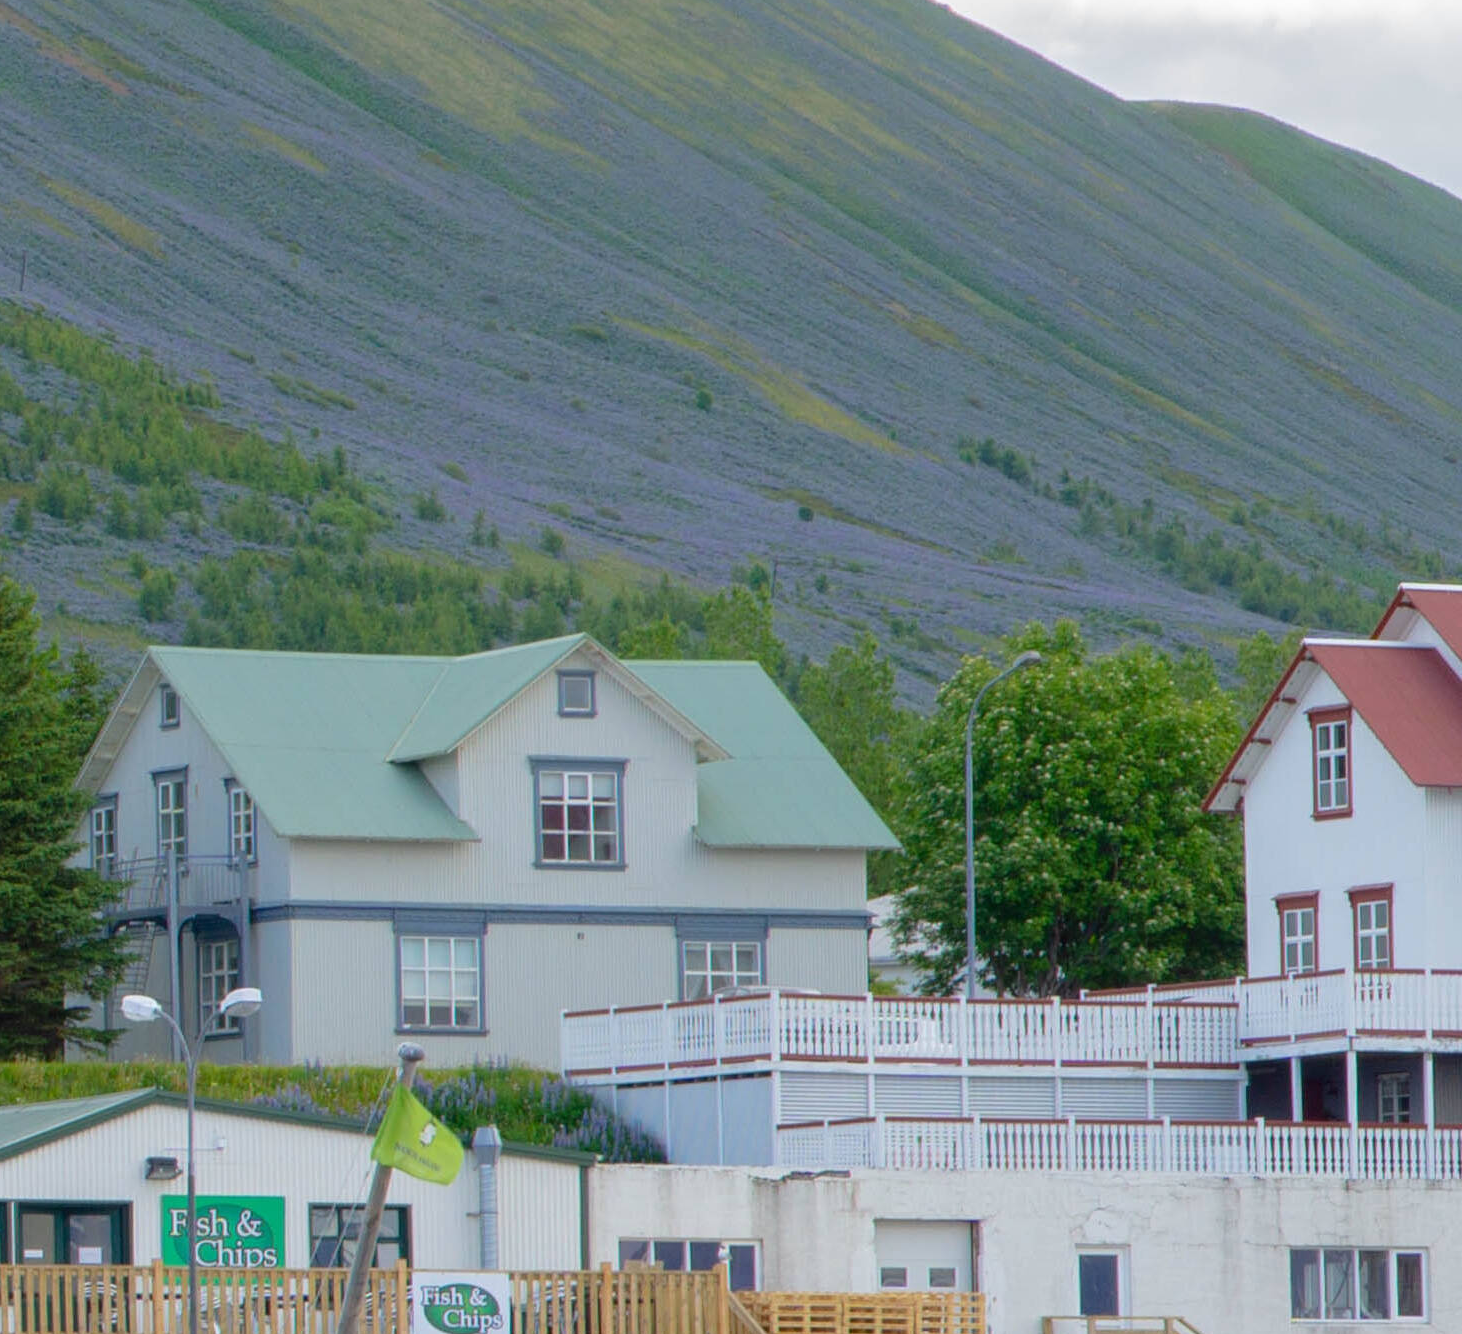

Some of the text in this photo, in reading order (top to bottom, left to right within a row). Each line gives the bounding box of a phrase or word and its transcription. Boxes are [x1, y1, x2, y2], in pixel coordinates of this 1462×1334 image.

[170, 1208, 263, 1237] Fsh &
[194, 1238, 278, 1268] Chips
[420, 1286, 488, 1307] Fish &
[442, 1308, 504, 1334] Chips
